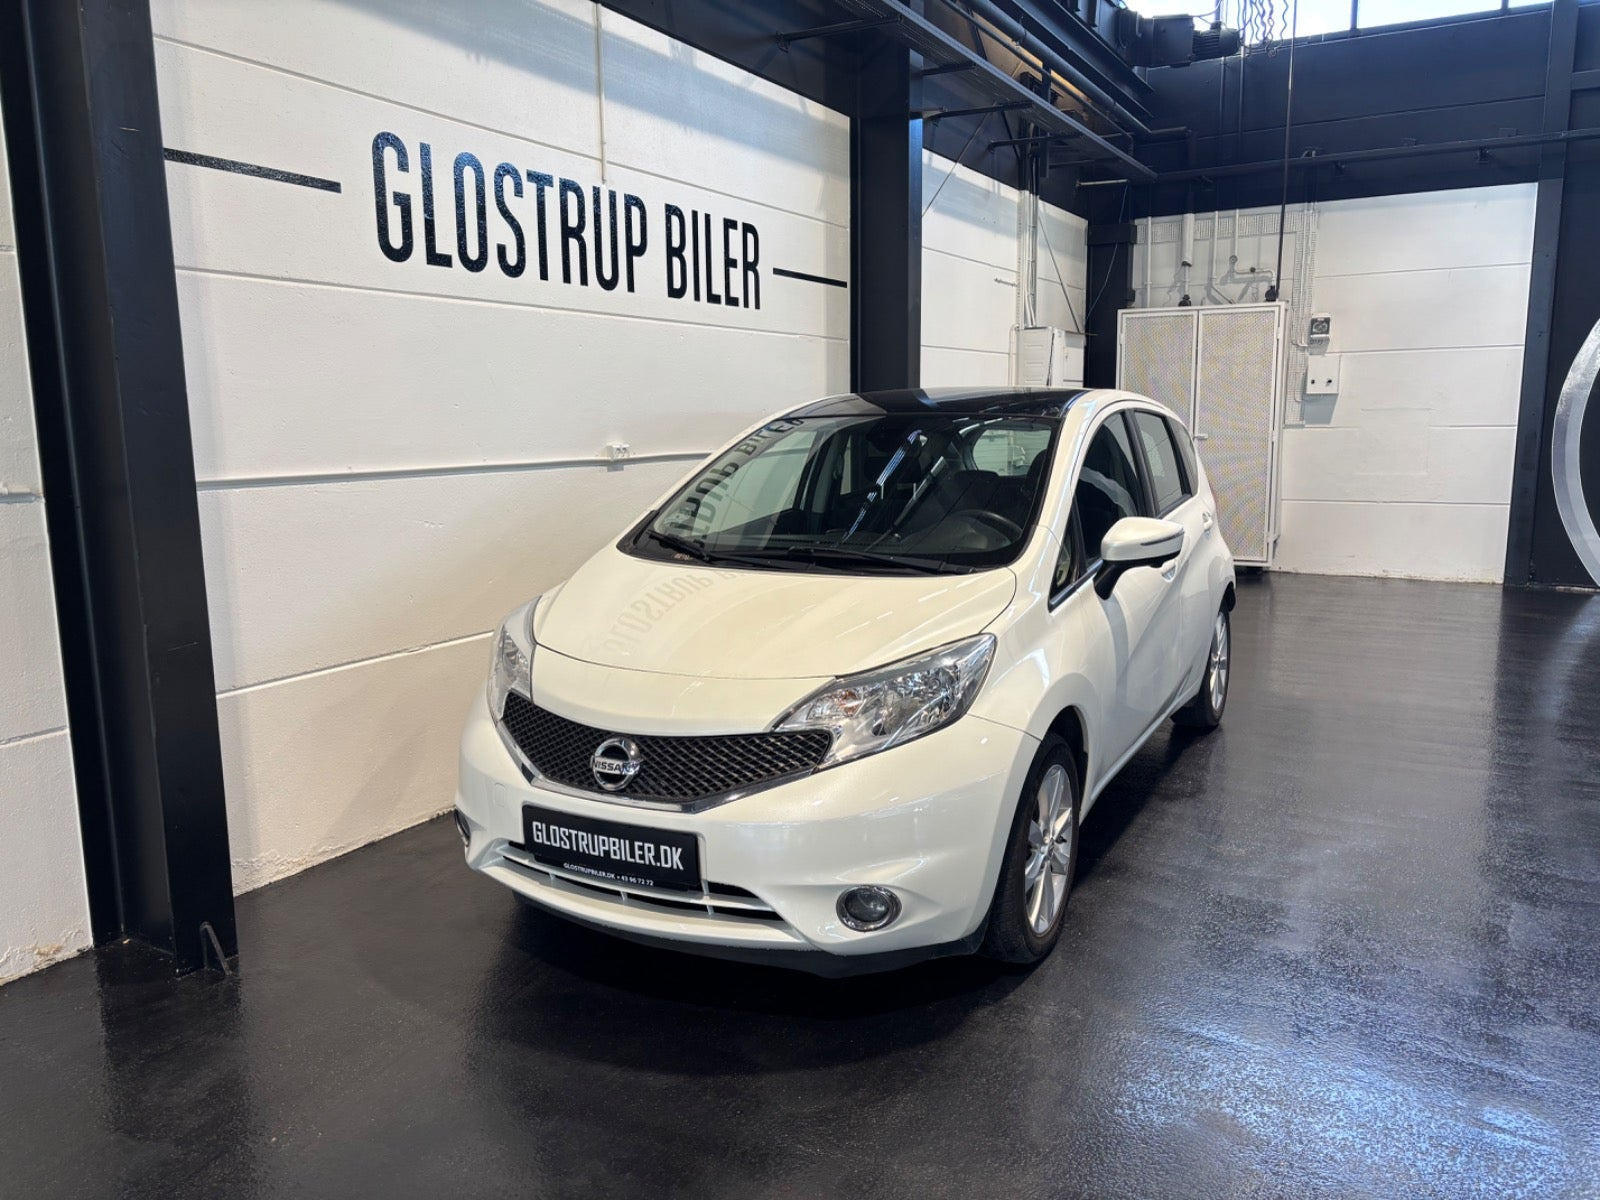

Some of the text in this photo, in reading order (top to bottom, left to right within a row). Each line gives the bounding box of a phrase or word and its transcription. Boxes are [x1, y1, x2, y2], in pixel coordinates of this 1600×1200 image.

[371, 130, 761, 310] GLOSTRUP BILER
[532, 821, 684, 870] GLOSTRUPBILER.DK
[563, 862, 616, 880] GLOSTRUPBILER.DK
